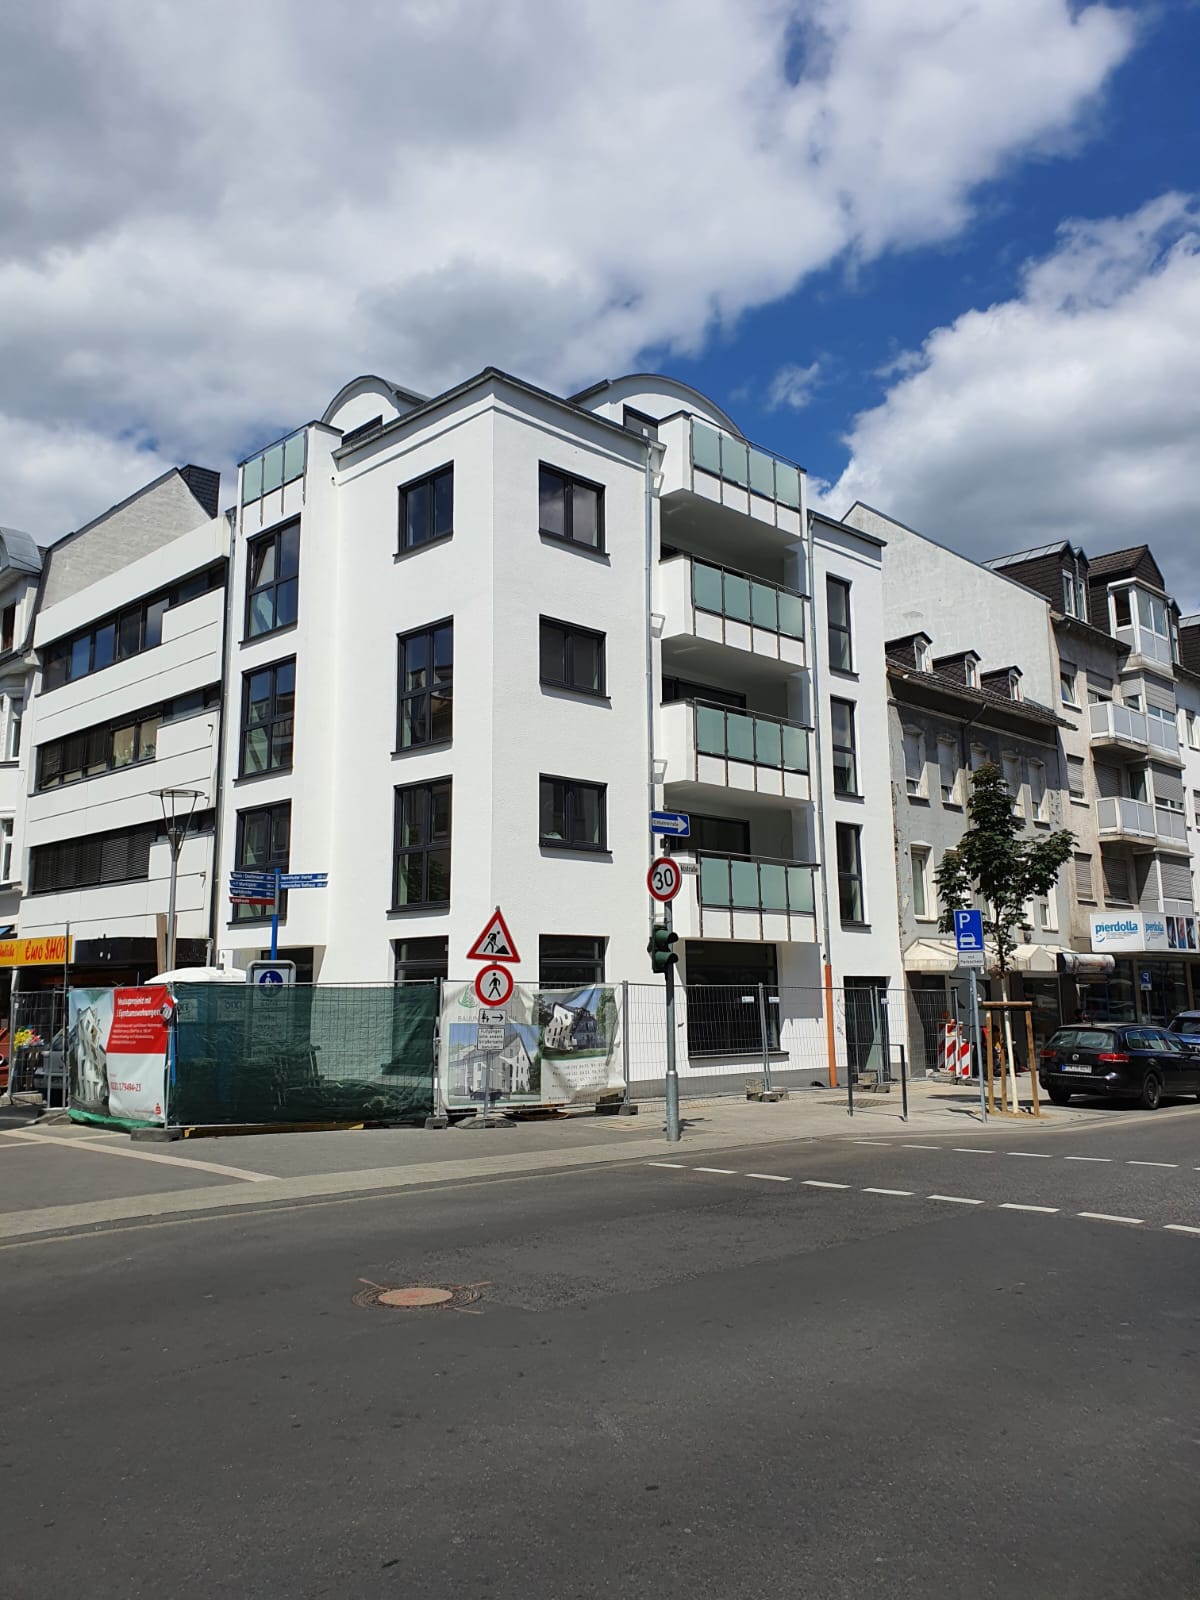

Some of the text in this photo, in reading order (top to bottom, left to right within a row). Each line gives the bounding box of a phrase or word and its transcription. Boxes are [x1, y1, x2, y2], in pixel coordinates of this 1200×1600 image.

[653, 868, 674, 891] 30
[959, 912, 971, 929] P
[1095, 920, 1138, 935] pierdolla
